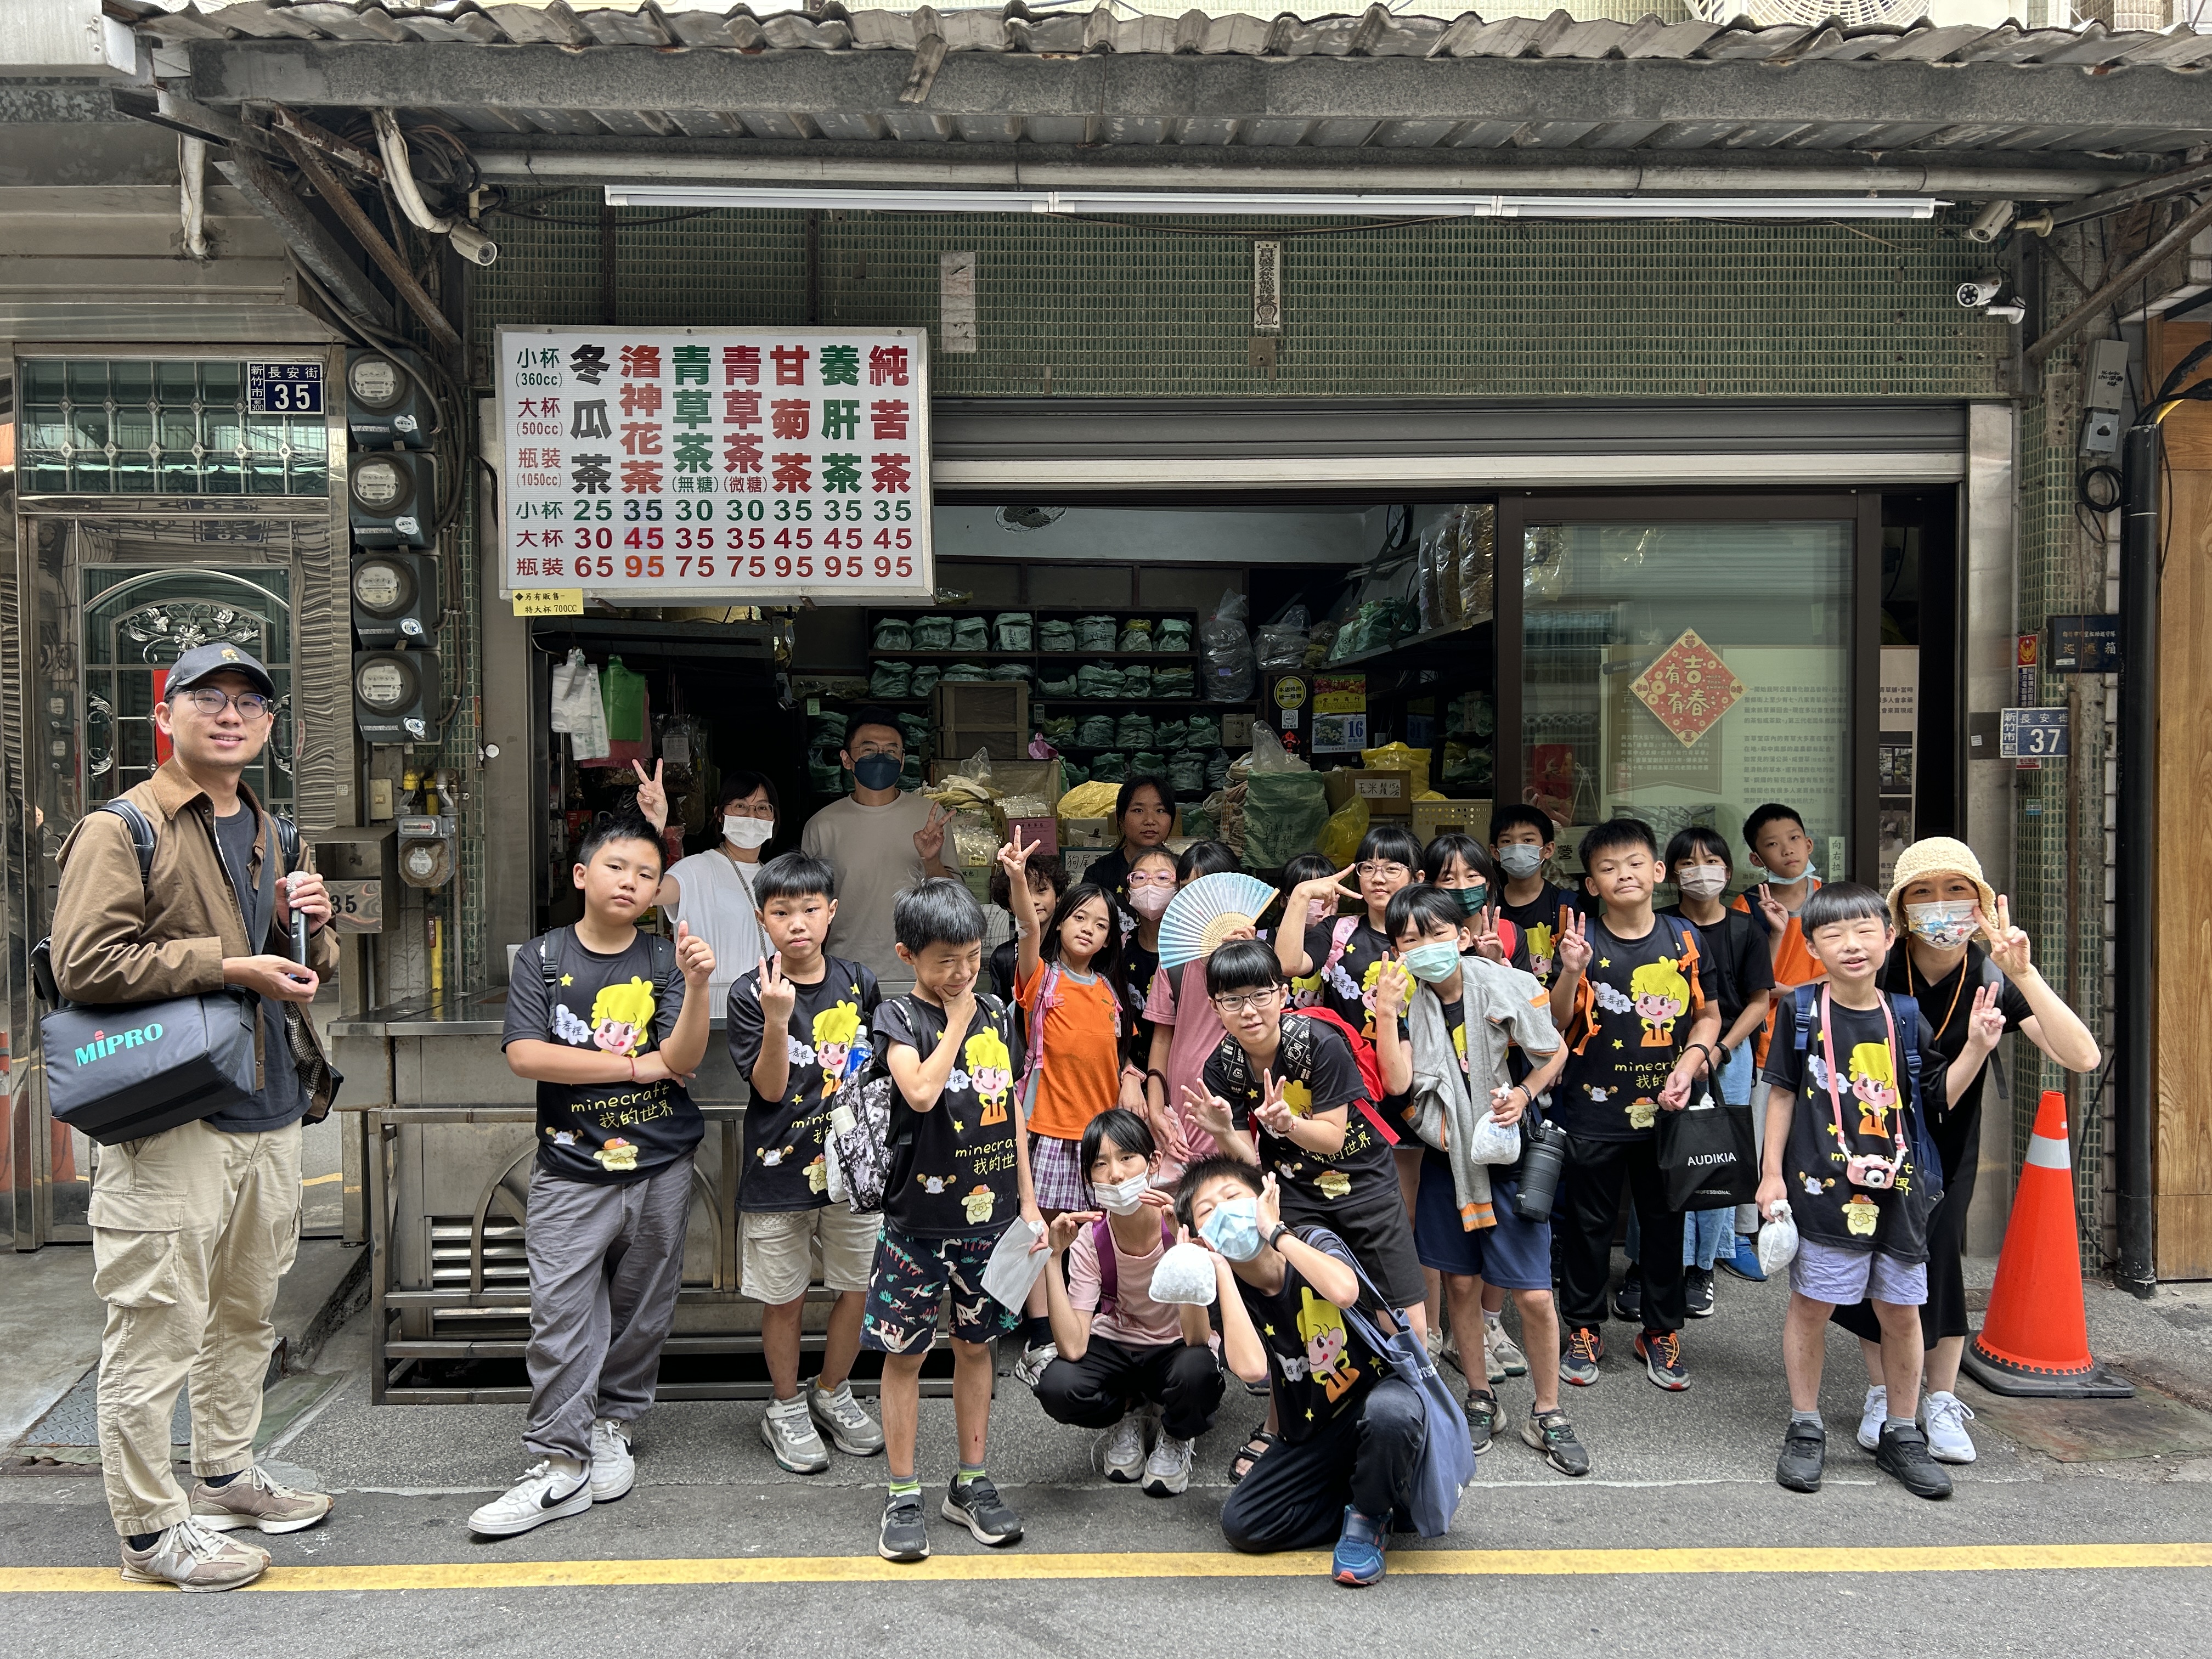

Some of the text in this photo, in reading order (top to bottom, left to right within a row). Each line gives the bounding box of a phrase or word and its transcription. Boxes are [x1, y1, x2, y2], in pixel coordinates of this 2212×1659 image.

[517, 348, 560, 368] 小杯
[251, 365, 263, 397] 新竹市
[268, 367, 318, 379] 長安街
[516, 373, 562, 387] (360cc)
[274, 384, 311, 410] 35
[518, 397, 560, 417] 大杯
[569, 345, 612, 494] 冬瓜茶
[619, 345, 663, 494] 洛神花茶
[672, 345, 713, 473] 青草茶
[723, 345, 764, 473] 青草茶
[770, 345, 812, 493] 甘菊茶
[820, 345, 862, 493] 養肝茶
[869, 345, 911, 493] 純苦茶
[517, 422, 562, 436] (500cc)
[518, 448, 561, 469] 瓶裝
[517, 473, 561, 488] (1050cc)
[673, 476, 718, 493] (無糖)
[724, 476, 767, 493] (微糖)
[516, 499, 911, 521] 小杯 25 35 30 30 35 35 35
[516, 527, 911, 549] 大杯 30 45 35 35 45 45 45
[517, 556, 912, 577] 瓶裝 65 95 75 75 95 95 95
[524, 604, 577, 614] 特大杯 700CC
[810, 703, 817, 713] 6
[1667, 687, 1711, 717] 有春
[1348, 720, 1363, 738] 16
[2004, 713, 2017, 741] 新竹市
[2019, 713, 2068, 724] 長安街
[2029, 728, 2061, 753] 37
[1358, 782, 1387, 795] 玉米鬚
[1557, 844, 1573, 860] 營
[1831, 840, 1842, 872] 向右拉
[330, 894, 357, 914] 35
[789, 1047, 810, 1060] 孝裡
[571, 1081, 669, 1114] minecraft
[599, 1099, 674, 1130] 我的世界
[955, 1139, 1018, 1158] minecra
[1312, 1131, 1371, 1163] 的世界
[973, 1153, 1018, 1175] 我的世
[1687, 1152, 1737, 1166] AUDIKIA
